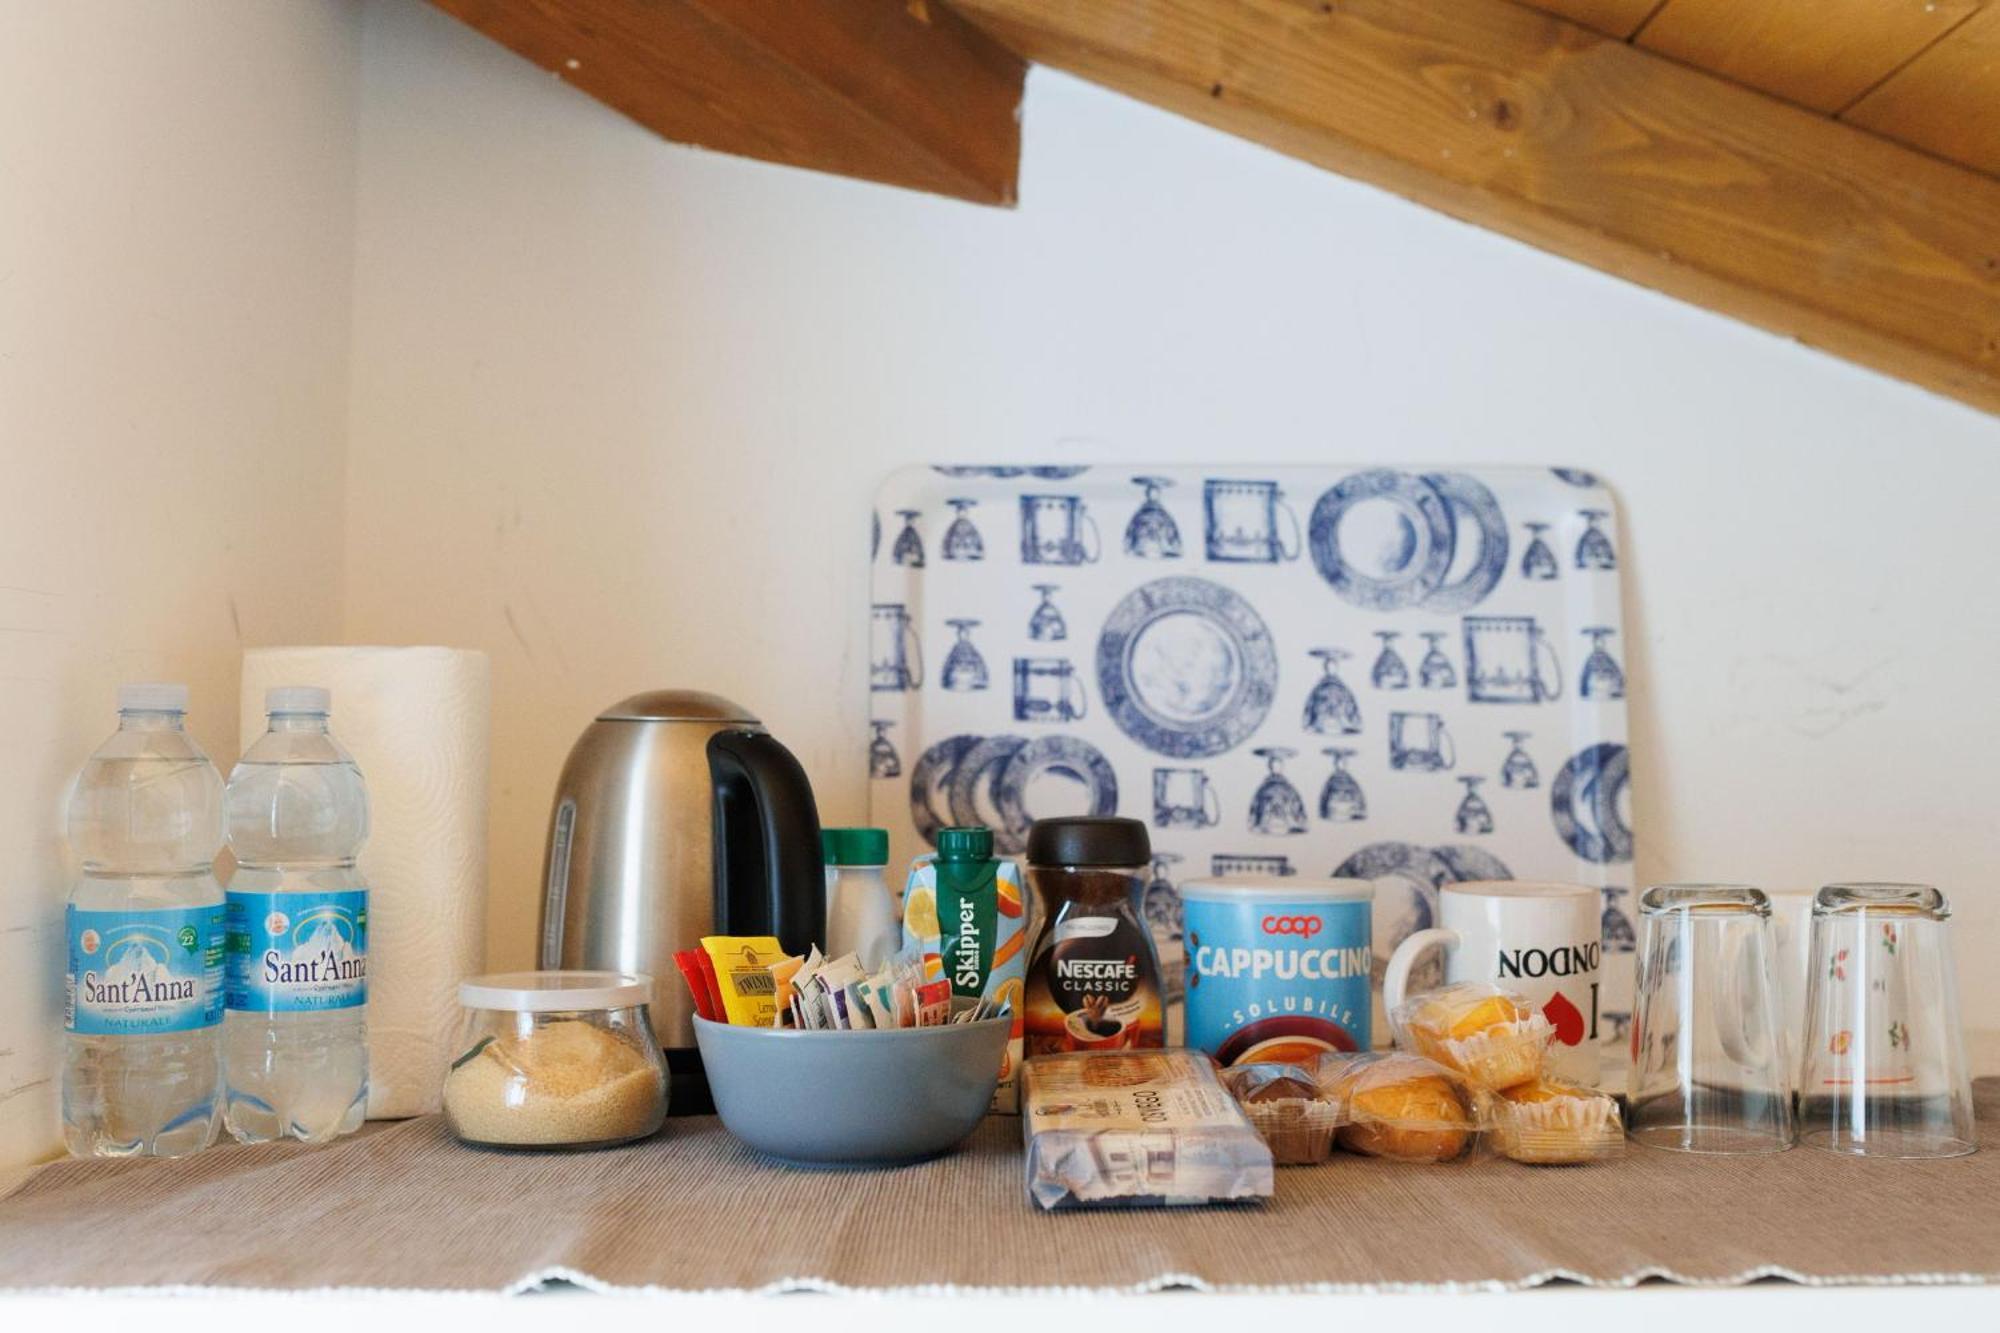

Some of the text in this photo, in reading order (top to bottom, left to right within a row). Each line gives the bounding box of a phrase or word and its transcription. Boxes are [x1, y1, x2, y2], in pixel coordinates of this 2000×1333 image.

[956, 897, 980, 988] Skipper
[1261, 916, 1323, 939] coop
[1196, 945, 1372, 980] CAPPUCCINO
[1498, 941, 1599, 978] ONDON
[85, 972, 194, 1003] Sant'Anna
[1062, 980, 1131, 992] CLASSIC
[1232, 996, 1353, 1025] SOLUBILE
